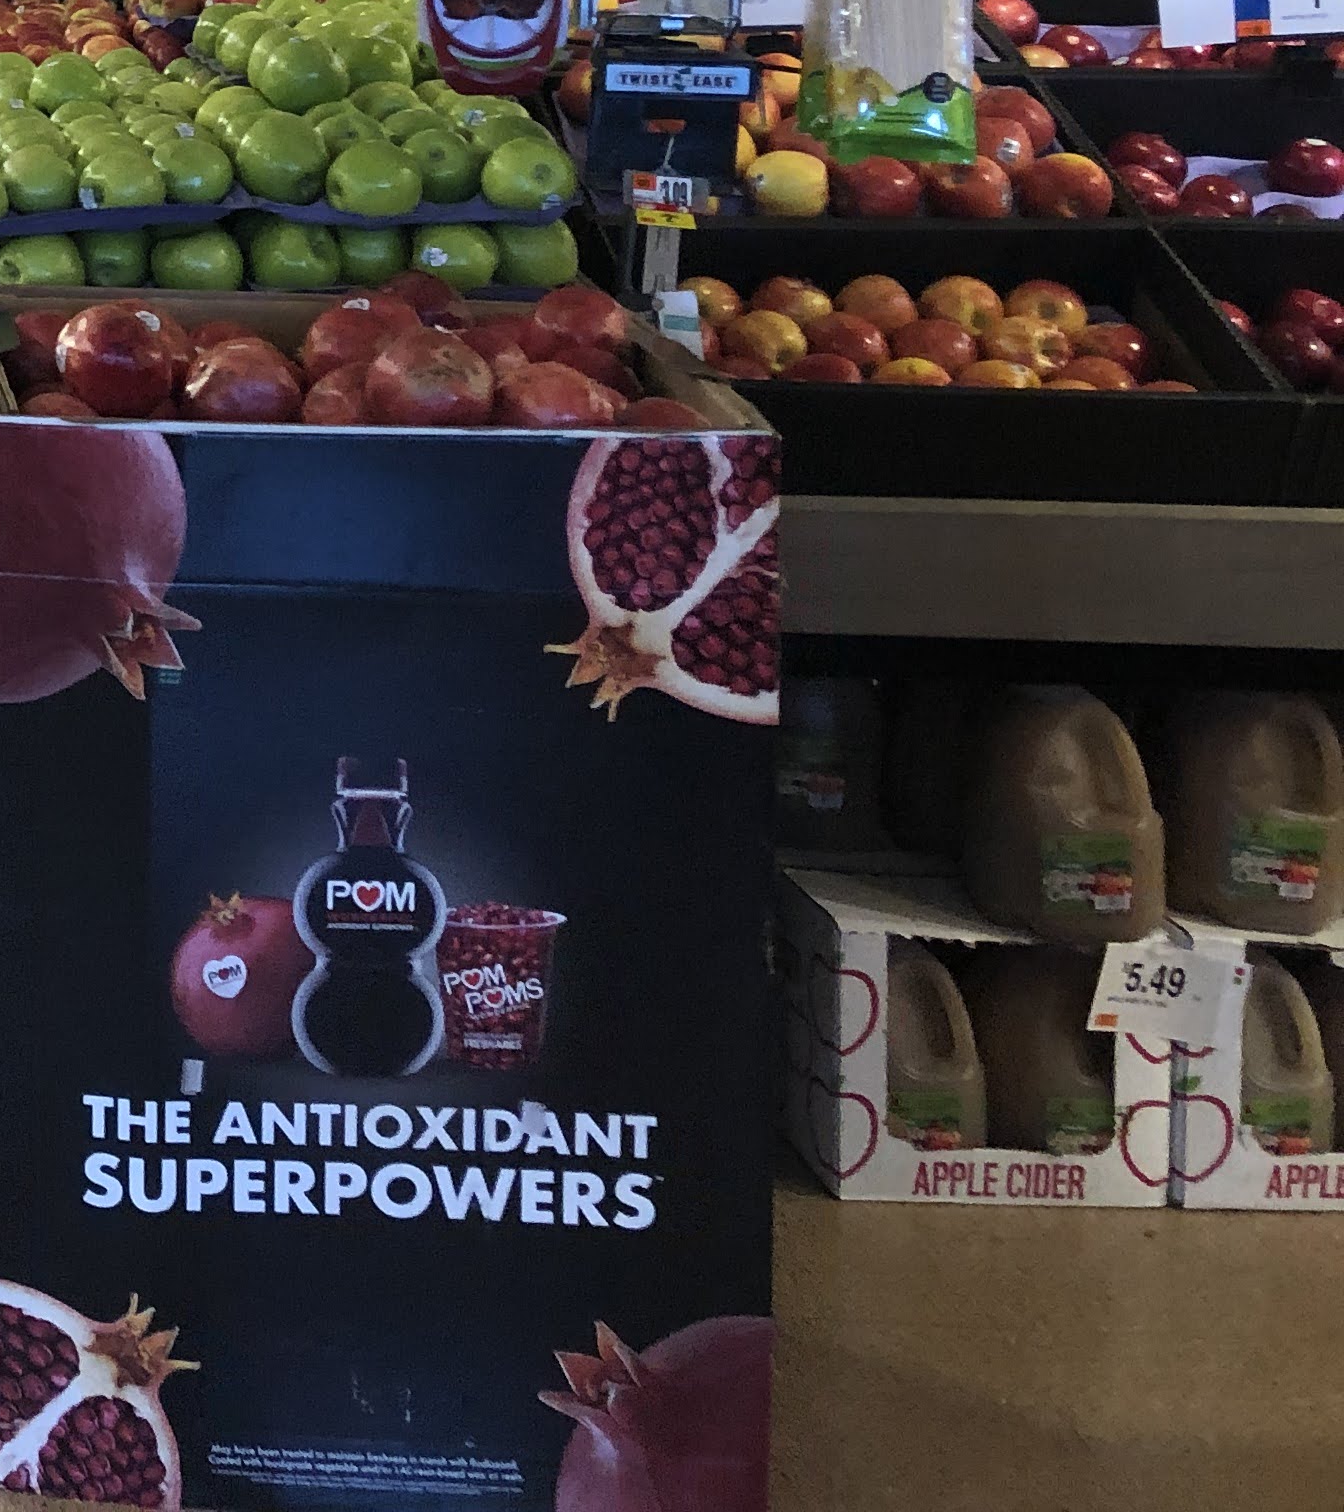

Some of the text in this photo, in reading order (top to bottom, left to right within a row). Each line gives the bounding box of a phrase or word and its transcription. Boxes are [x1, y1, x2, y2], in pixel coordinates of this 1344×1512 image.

[620, 73, 736, 89] TWIST EASE
[326, 879, 416, 913] POM
[207, 963, 242, 985] POM
[443, 962, 508, 995] POM
[464, 976, 545, 1017] POMS
[83, 1093, 658, 1160] THE ANTIOXIDANT
[81, 1152, 656, 1231] SUPERPOWERS
[912, 1161, 1087, 1200] APPLE CIDER
